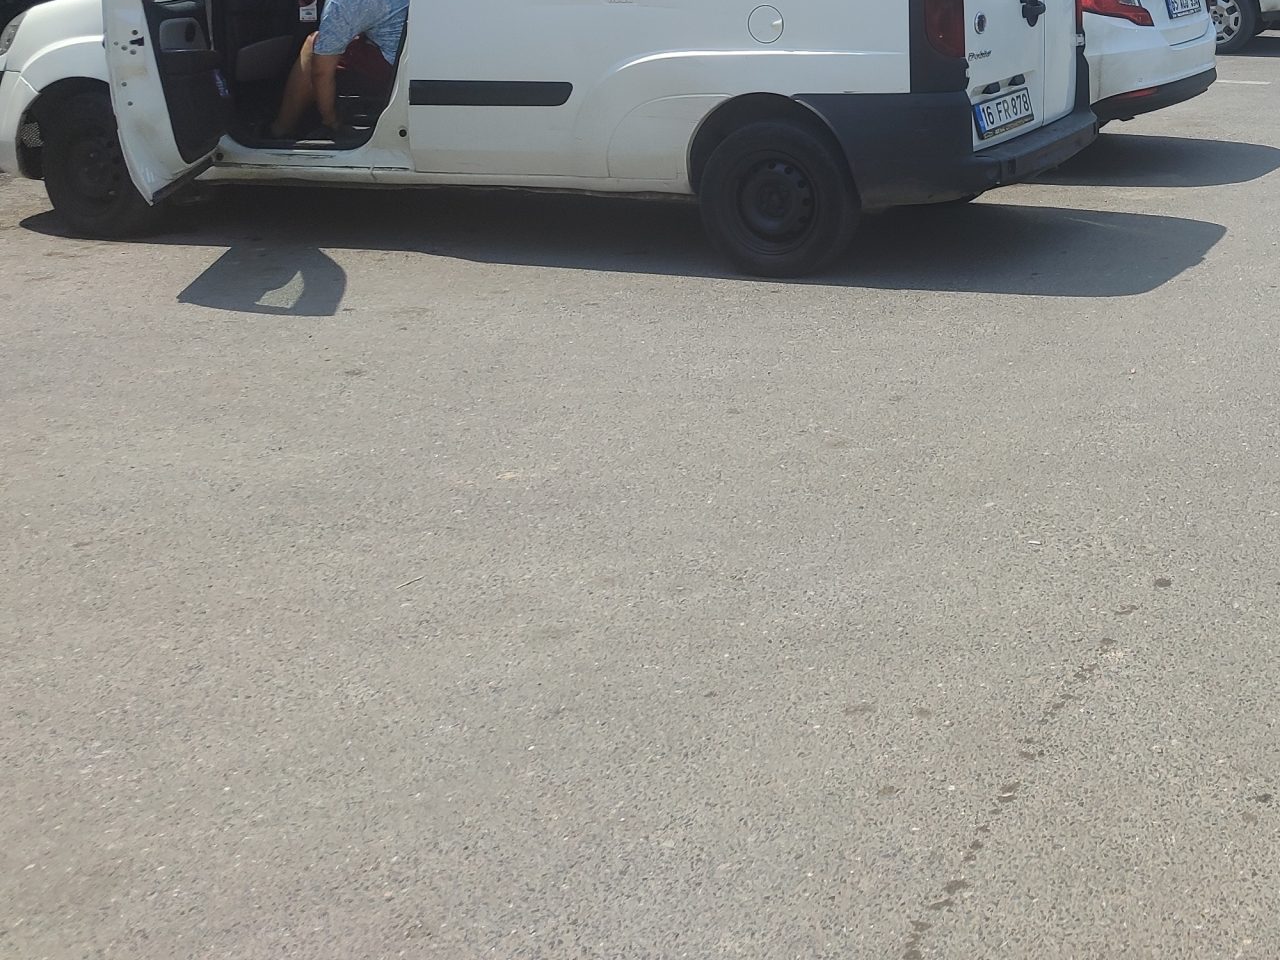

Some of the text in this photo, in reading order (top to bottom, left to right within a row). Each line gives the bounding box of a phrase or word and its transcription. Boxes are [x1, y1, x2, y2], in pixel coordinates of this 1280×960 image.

[982, 106, 995, 127] 16
[996, 100, 1012, 122] FR
[1011, 93, 1030, 117] 878
